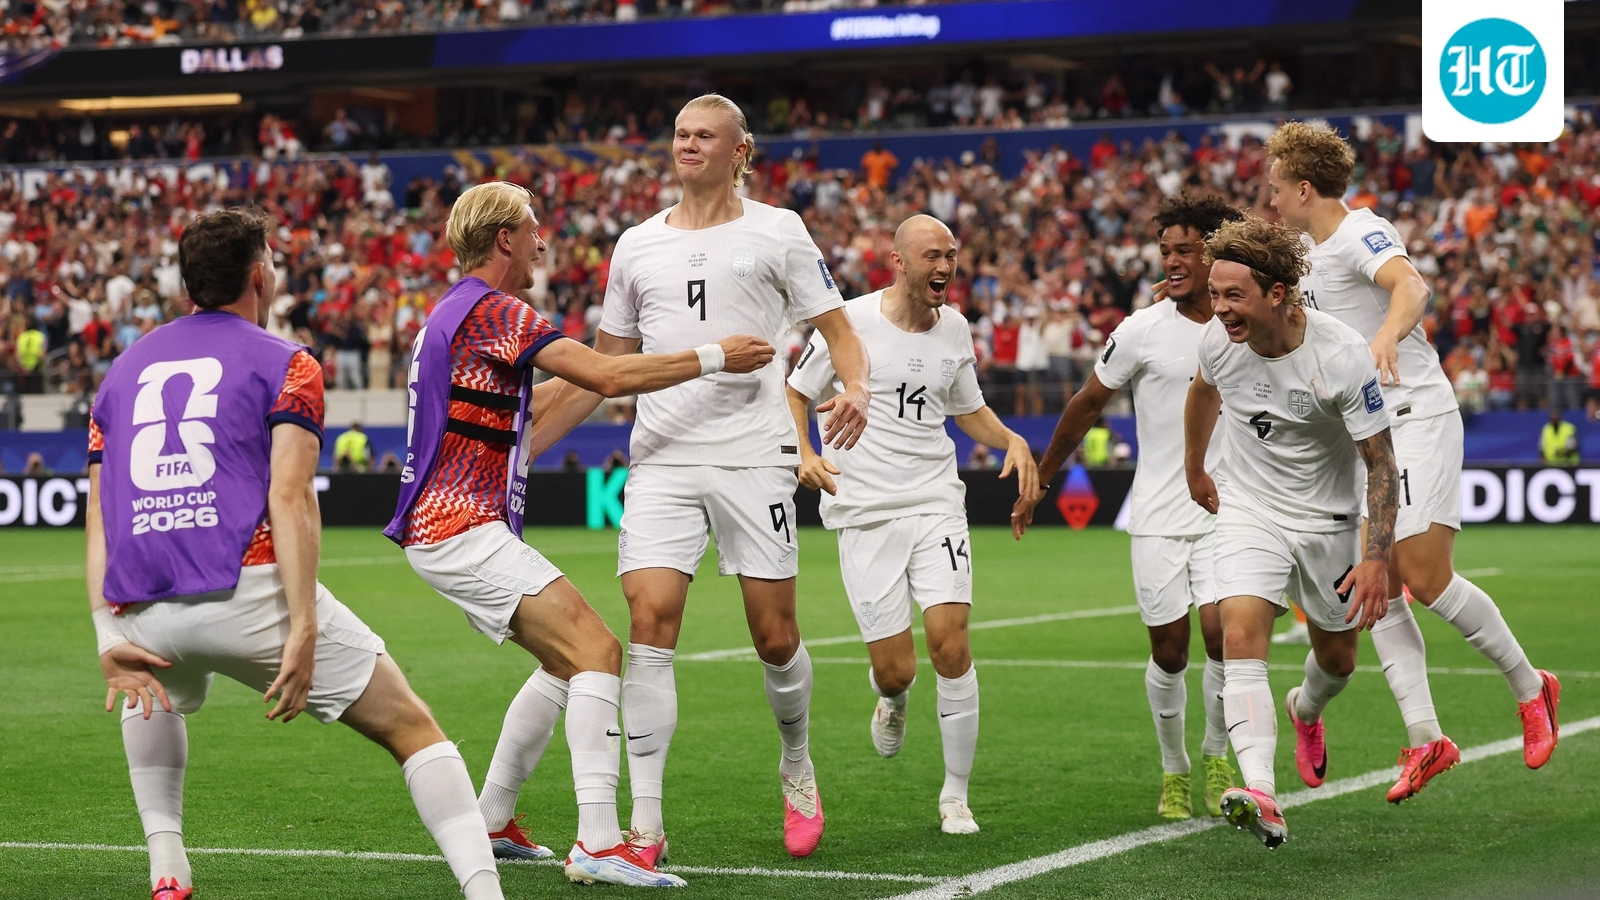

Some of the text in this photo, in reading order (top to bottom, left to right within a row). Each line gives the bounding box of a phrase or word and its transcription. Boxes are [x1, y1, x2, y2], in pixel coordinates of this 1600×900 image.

[181, 45, 284, 74] DALLAS
[687, 279, 706, 321] 9
[896, 382, 927, 421] 14
[156, 461, 193, 478] FIFA
[132, 491, 217, 512] WORLD CUP
[132, 506, 219, 535] 2026
[768, 502, 790, 544] 9
[941, 536, 970, 574] 14
